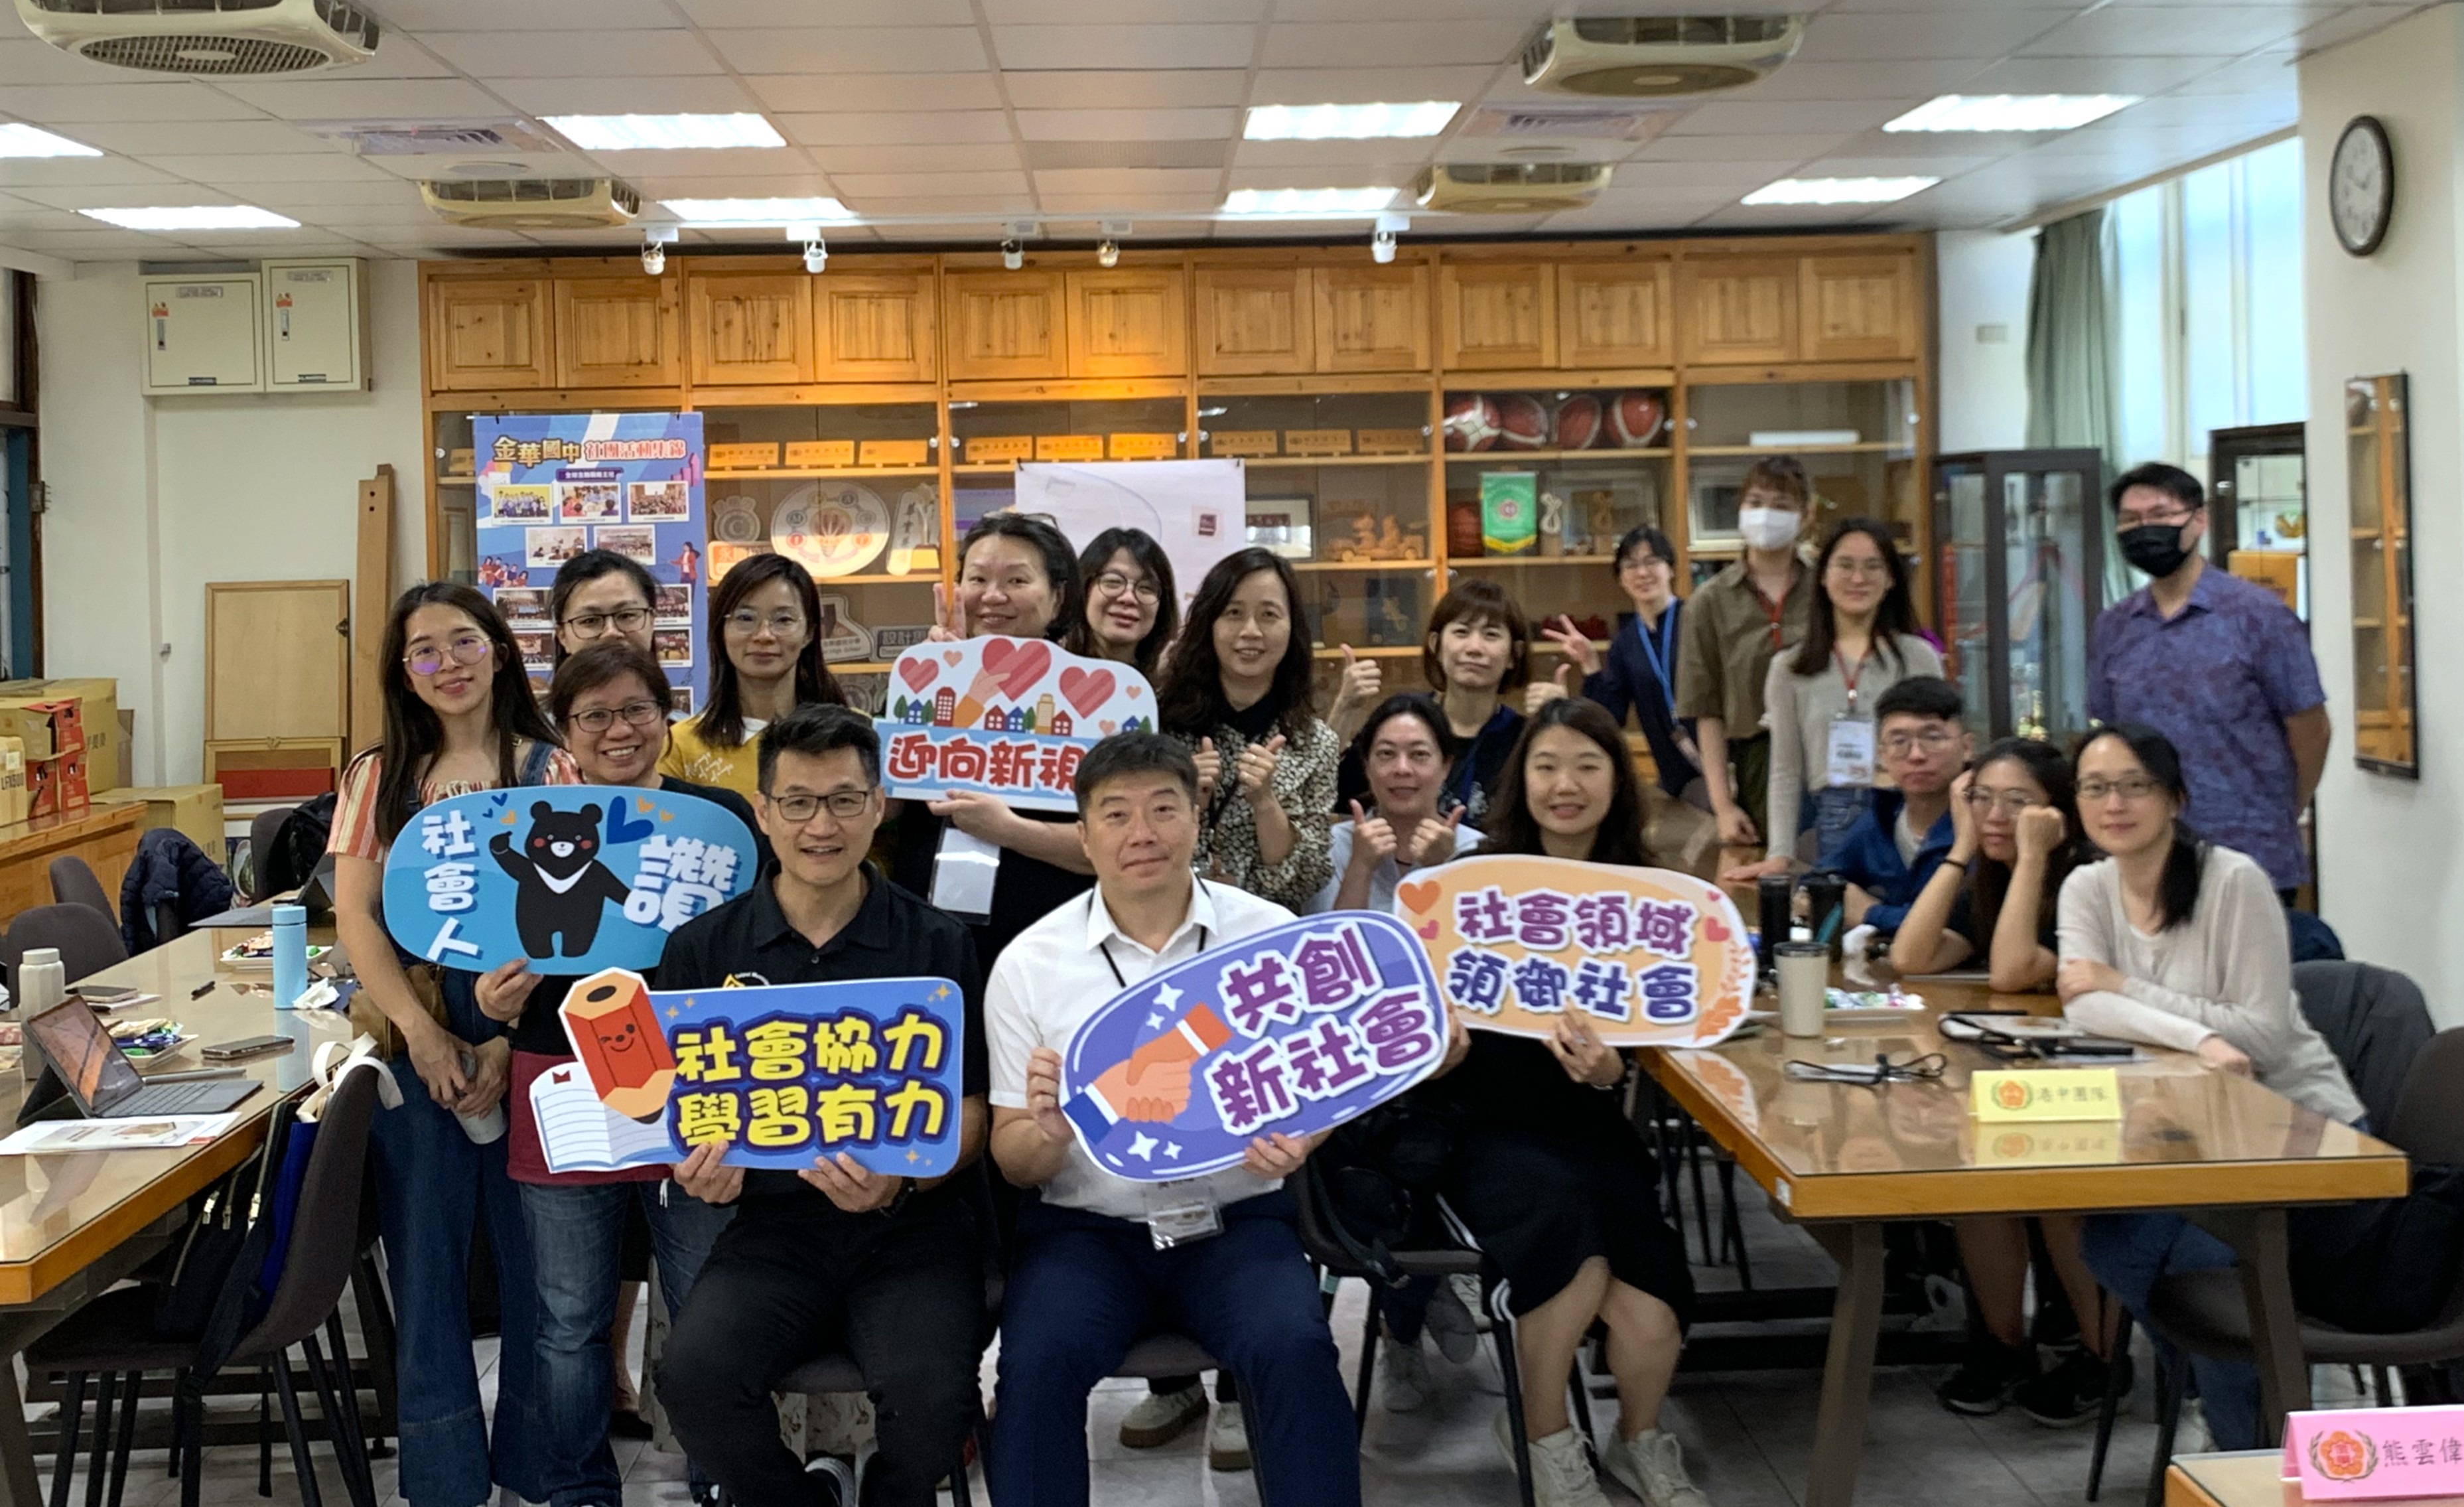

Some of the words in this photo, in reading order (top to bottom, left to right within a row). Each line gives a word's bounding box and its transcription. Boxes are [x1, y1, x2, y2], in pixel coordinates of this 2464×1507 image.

[493, 436, 581, 468] 金華國中
[888, 734, 1086, 791] 迎向新視
[421, 810, 480, 962] 社會人
[623, 834, 740, 934] 讚
[1459, 890, 1694, 956] 社會領域
[1224, 926, 1375, 1032] 共創
[1448, 950, 1693, 1020] 領御社會
[676, 1013, 943, 1082] 社會協力
[1211, 991, 1432, 1129] 新社會
[677, 1080, 944, 1147] 學習有力
[2382, 1437, 2463, 1468] 熊雲偉
